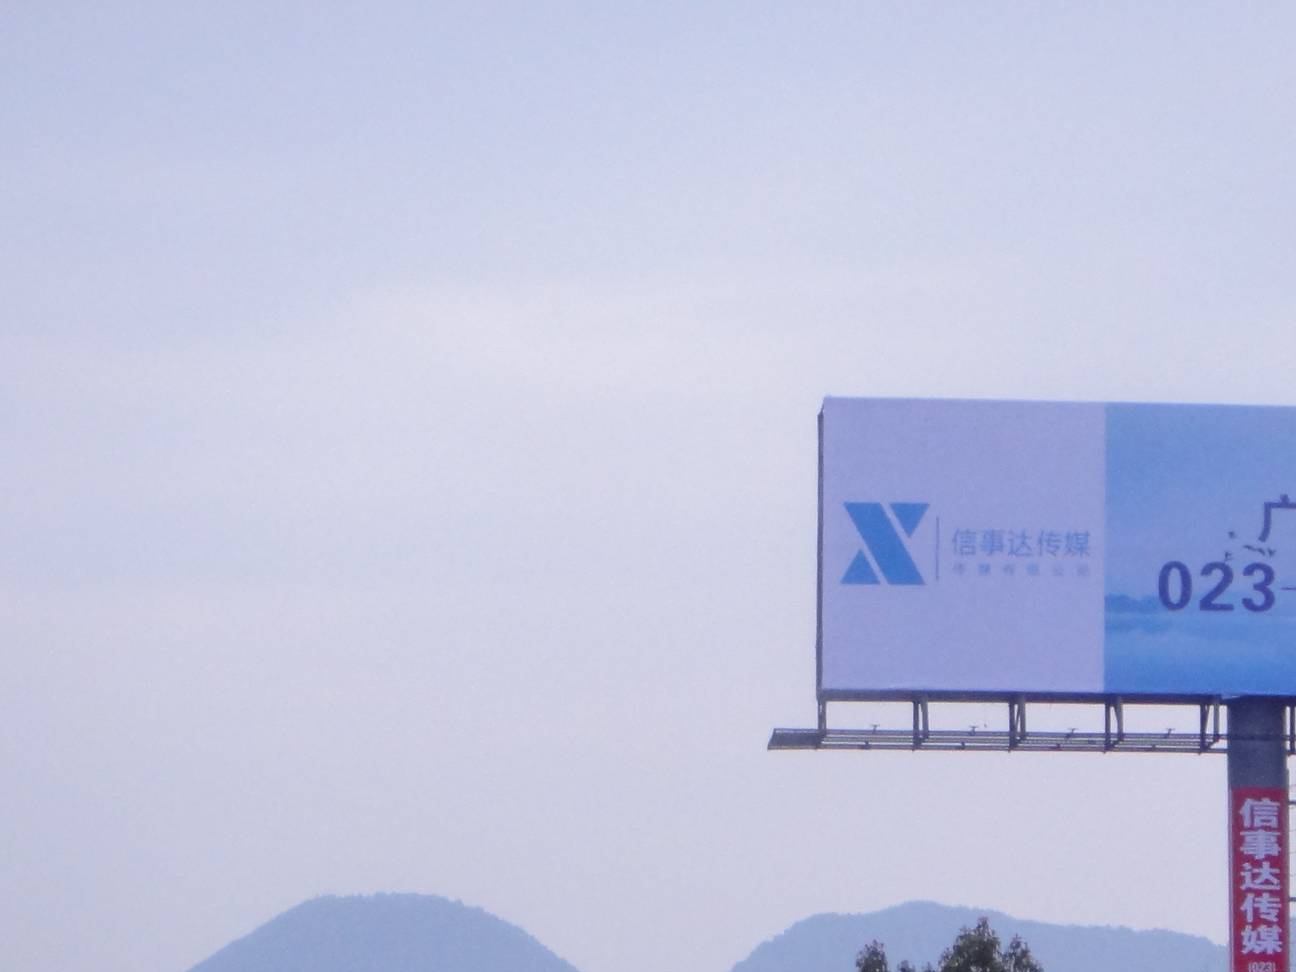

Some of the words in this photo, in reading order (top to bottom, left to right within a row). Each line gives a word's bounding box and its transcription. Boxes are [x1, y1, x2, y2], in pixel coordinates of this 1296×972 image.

[952, 528, 1091, 557] 信事达传媒
[1239, 797, 1283, 955] 信事达传媒
